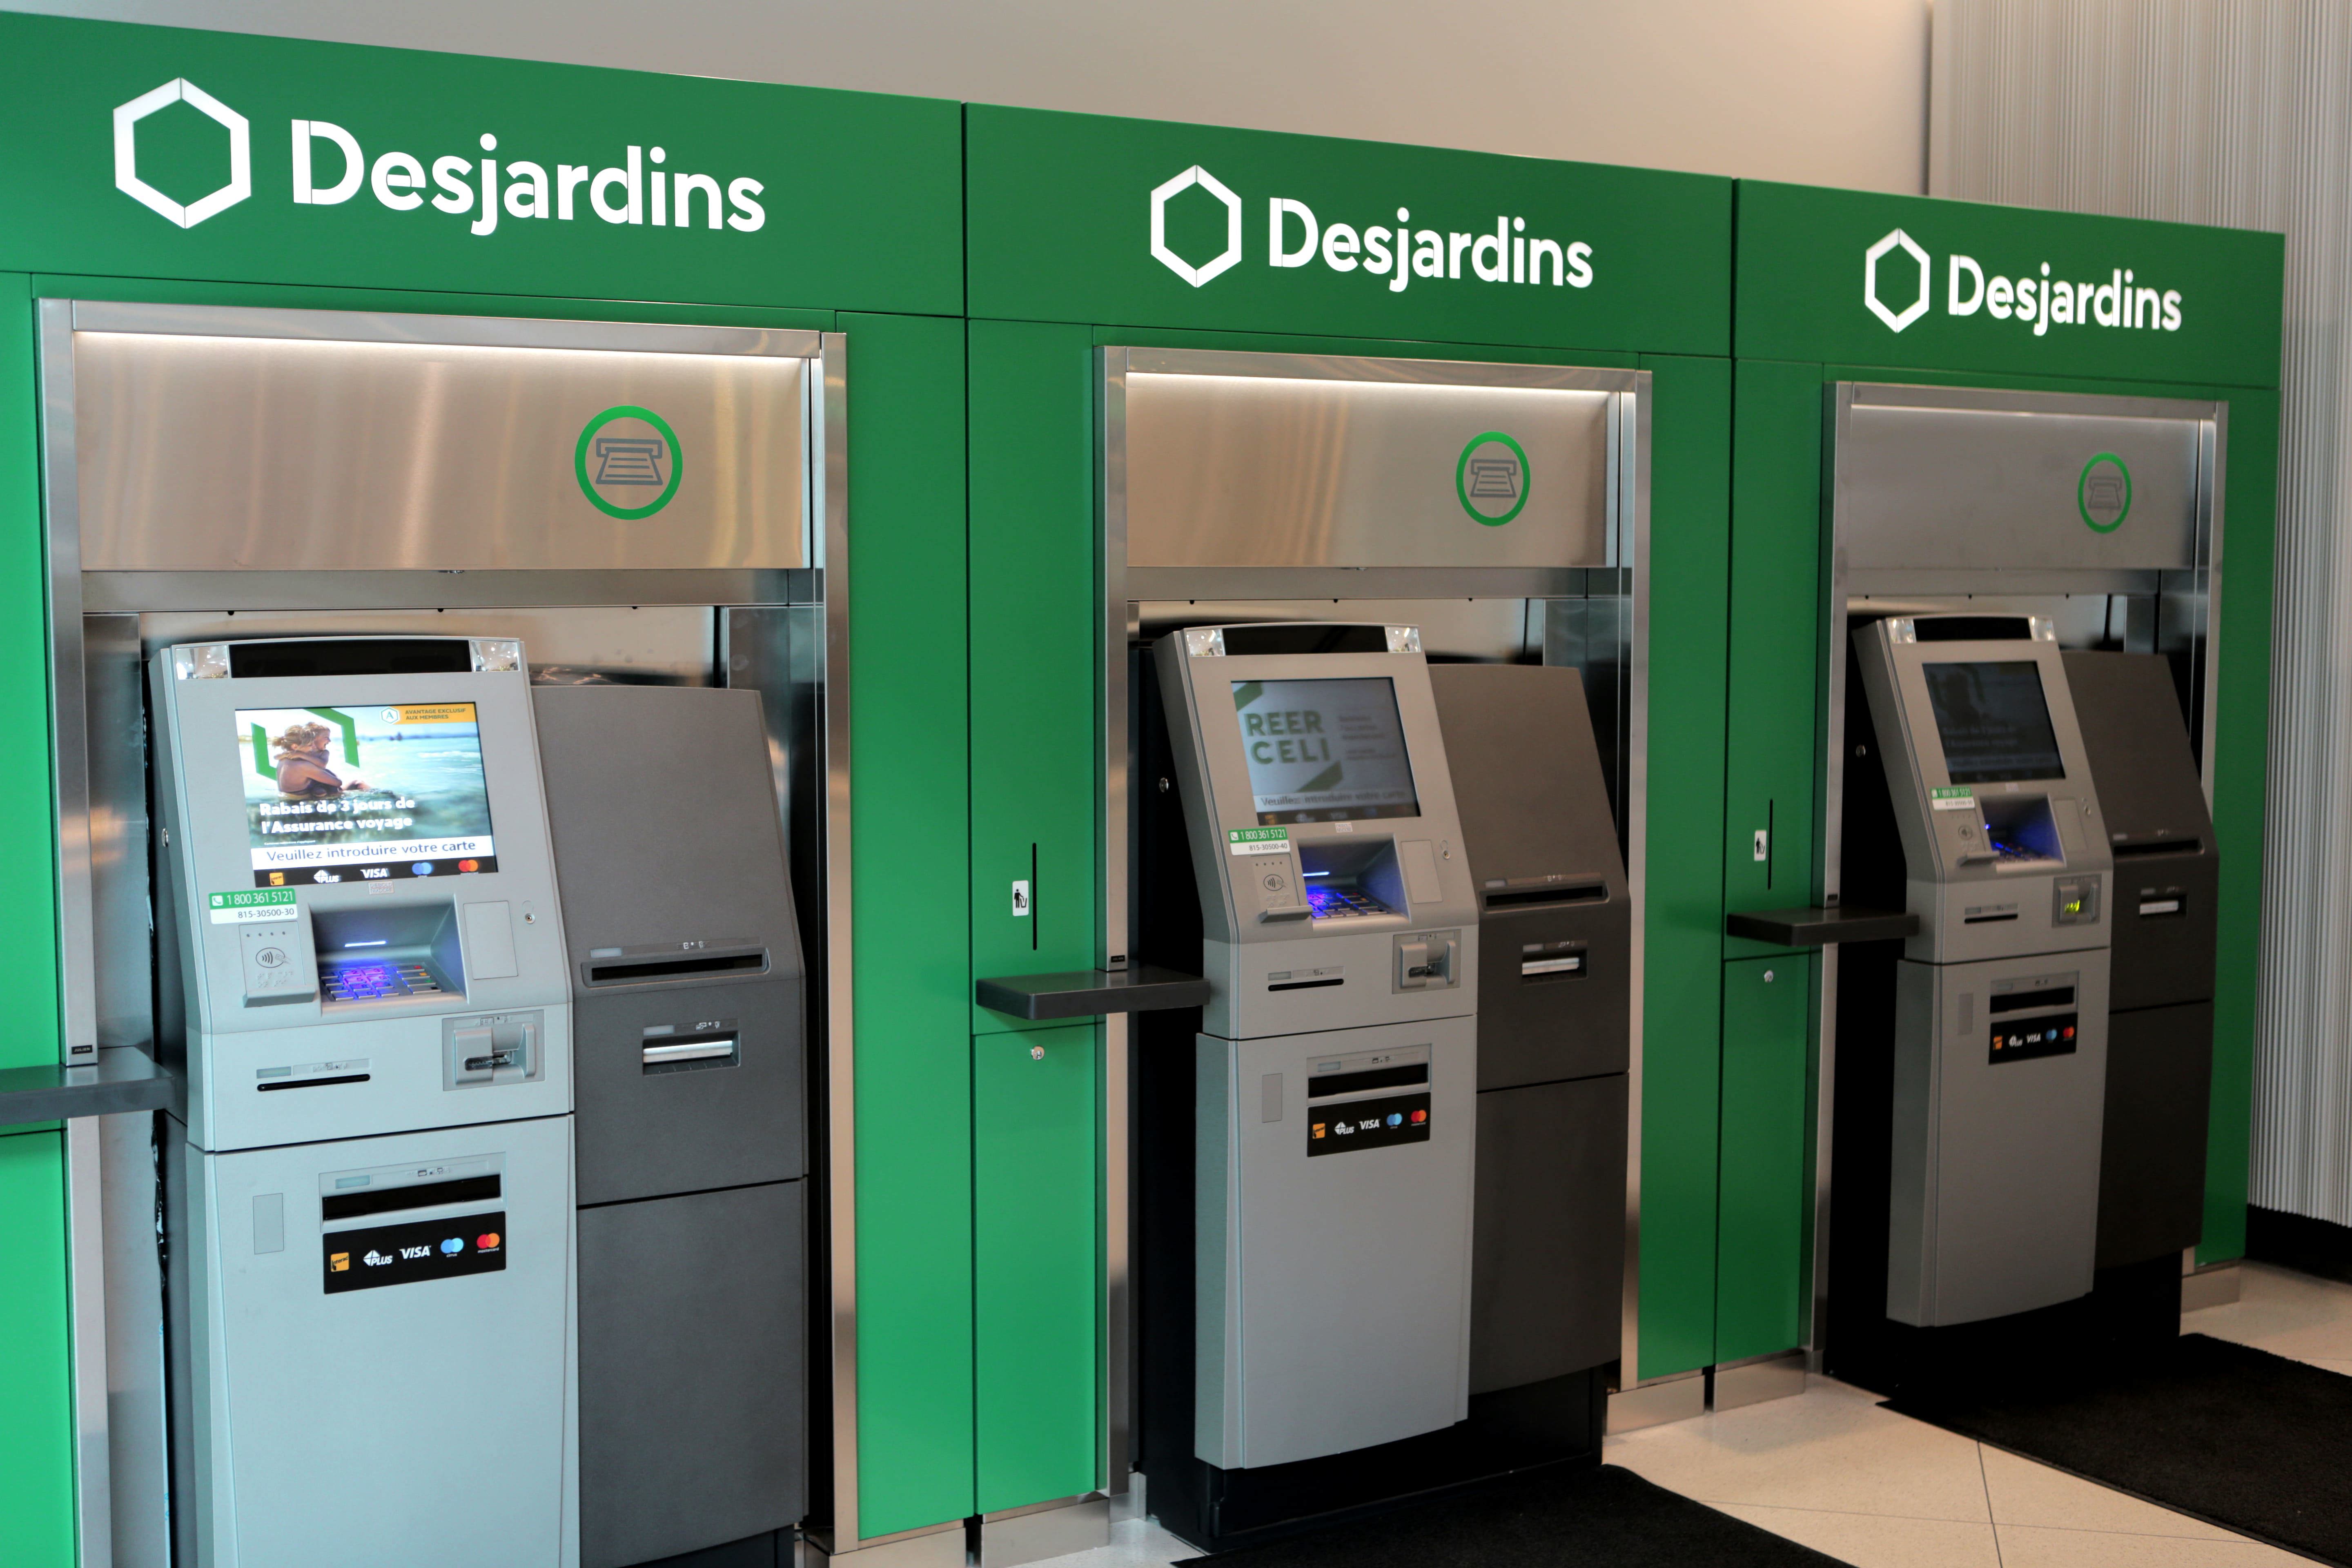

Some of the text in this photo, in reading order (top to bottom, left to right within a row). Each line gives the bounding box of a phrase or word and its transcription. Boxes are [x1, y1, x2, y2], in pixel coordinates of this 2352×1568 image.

[291, 119, 766, 236] Desjardins
[1269, 197, 1593, 292] Desjardins
[1948, 254, 2182, 336] Desjardins
[1244, 711, 1324, 736] REER
[1250, 738, 1330, 765] CELI
[260, 797, 415, 815] Rabais de 3 jours de
[261, 817, 412, 833] l'Assurance voyage
[1241, 829, 1286, 840] 1 800 361 5121
[267, 841, 476, 862] Veuillez introduire votre carte
[360, 868, 388, 878] VISA
[227, 891, 293, 905] 1 800 361 5121
[238, 908, 294, 918] 815-30500-30
[1340, 1126, 1354, 1135] PLUS
[1359, 1119, 1380, 1130] VISA
[399, 1246, 430, 1259] VISA
[371, 1255, 393, 1266] PLUS
